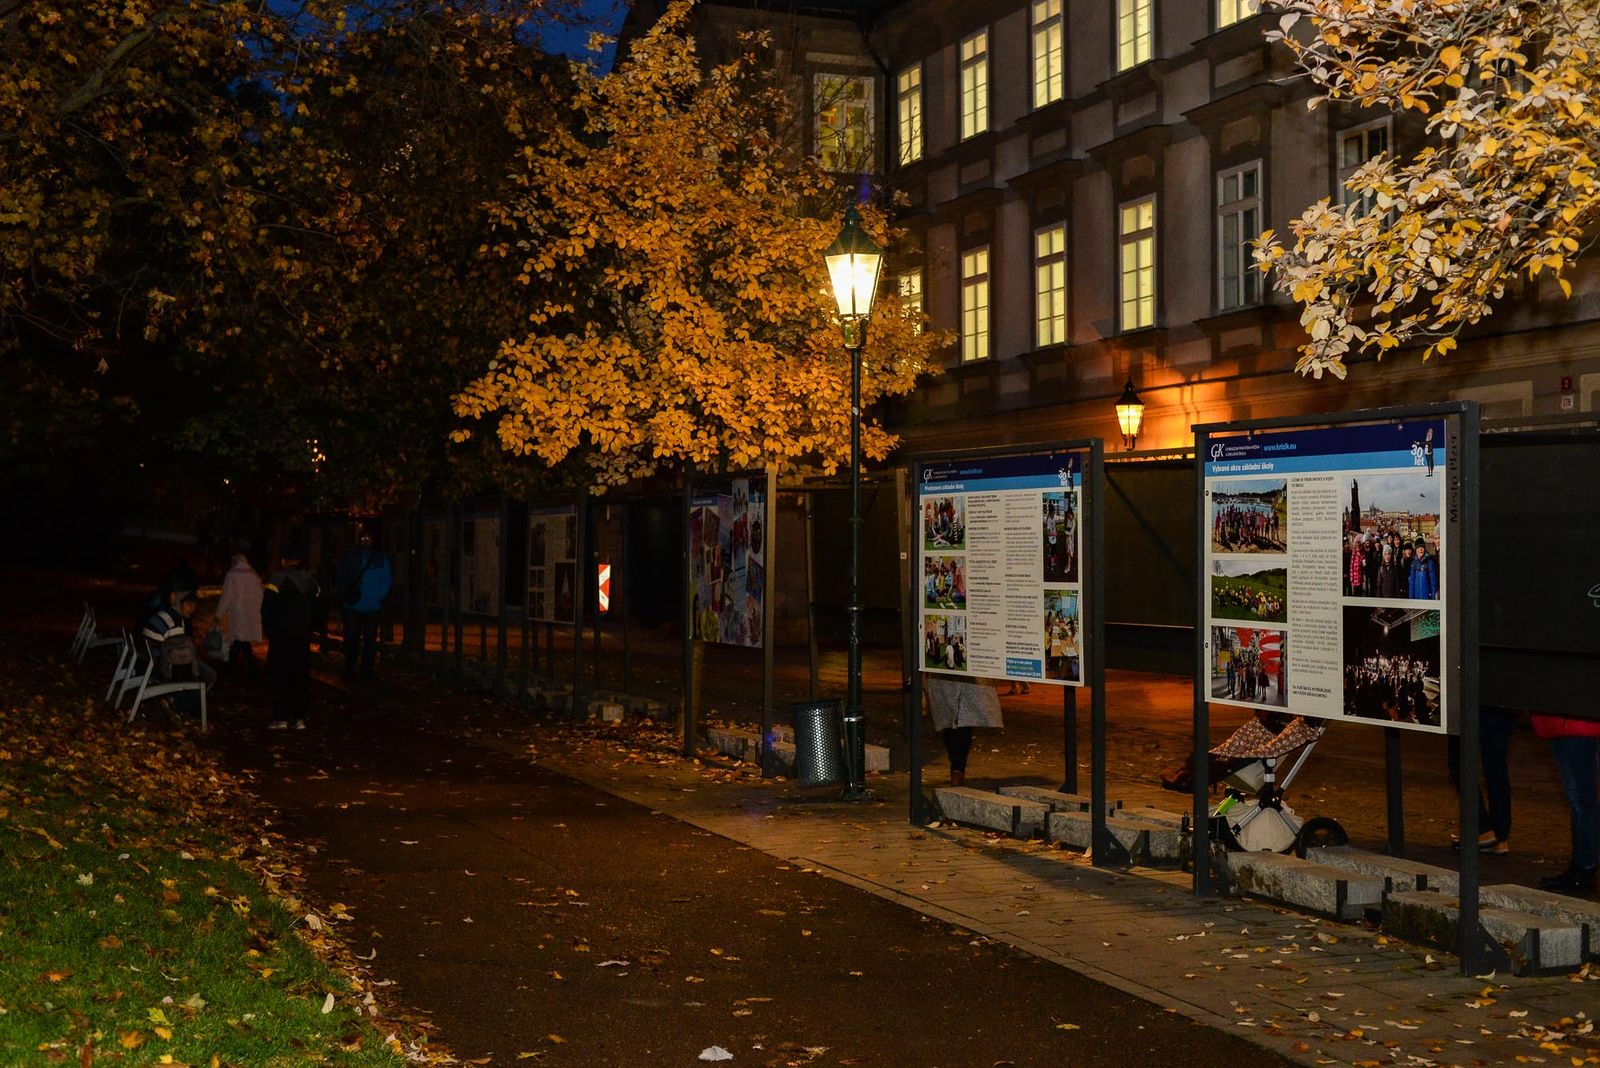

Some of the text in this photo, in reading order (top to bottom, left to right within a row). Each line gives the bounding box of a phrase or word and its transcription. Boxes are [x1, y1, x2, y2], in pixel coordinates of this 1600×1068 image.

[1411, 444, 1423, 457] 30
[1414, 457, 1424, 465] let
[1241, 462, 1261, 471] základní
